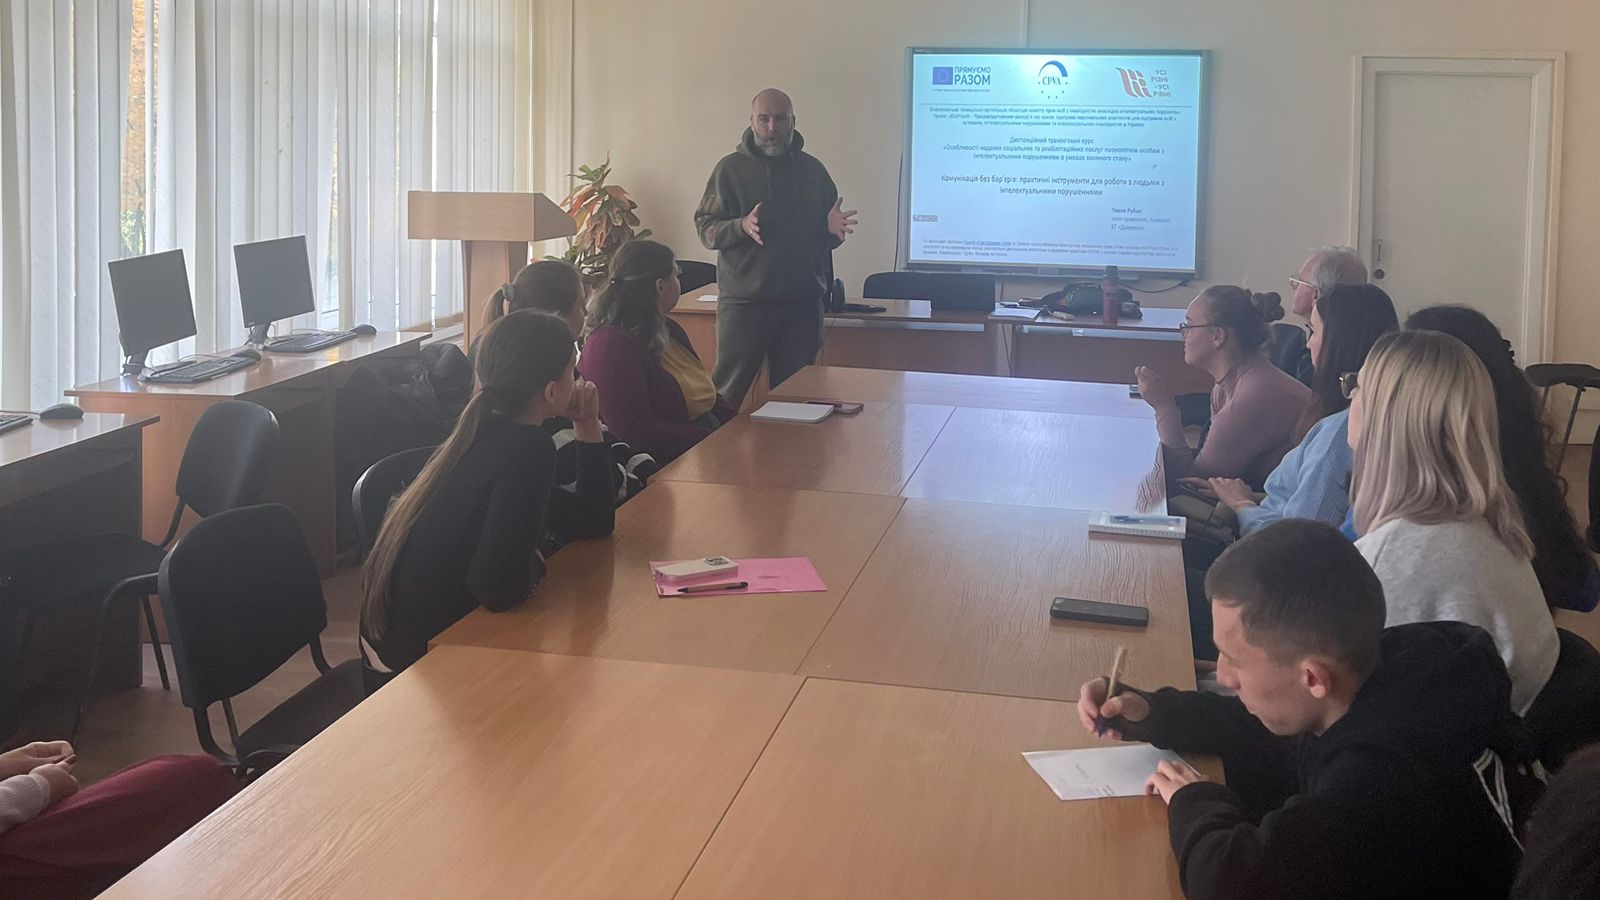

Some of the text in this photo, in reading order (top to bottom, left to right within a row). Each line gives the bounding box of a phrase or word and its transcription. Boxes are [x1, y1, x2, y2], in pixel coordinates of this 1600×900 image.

[954, 74, 991, 85] РАЗОМ
[942, 174, 978, 183] Комунікація
[1052, 176, 1089, 185] інструменти
[1104, 177, 1126, 186] роботи
